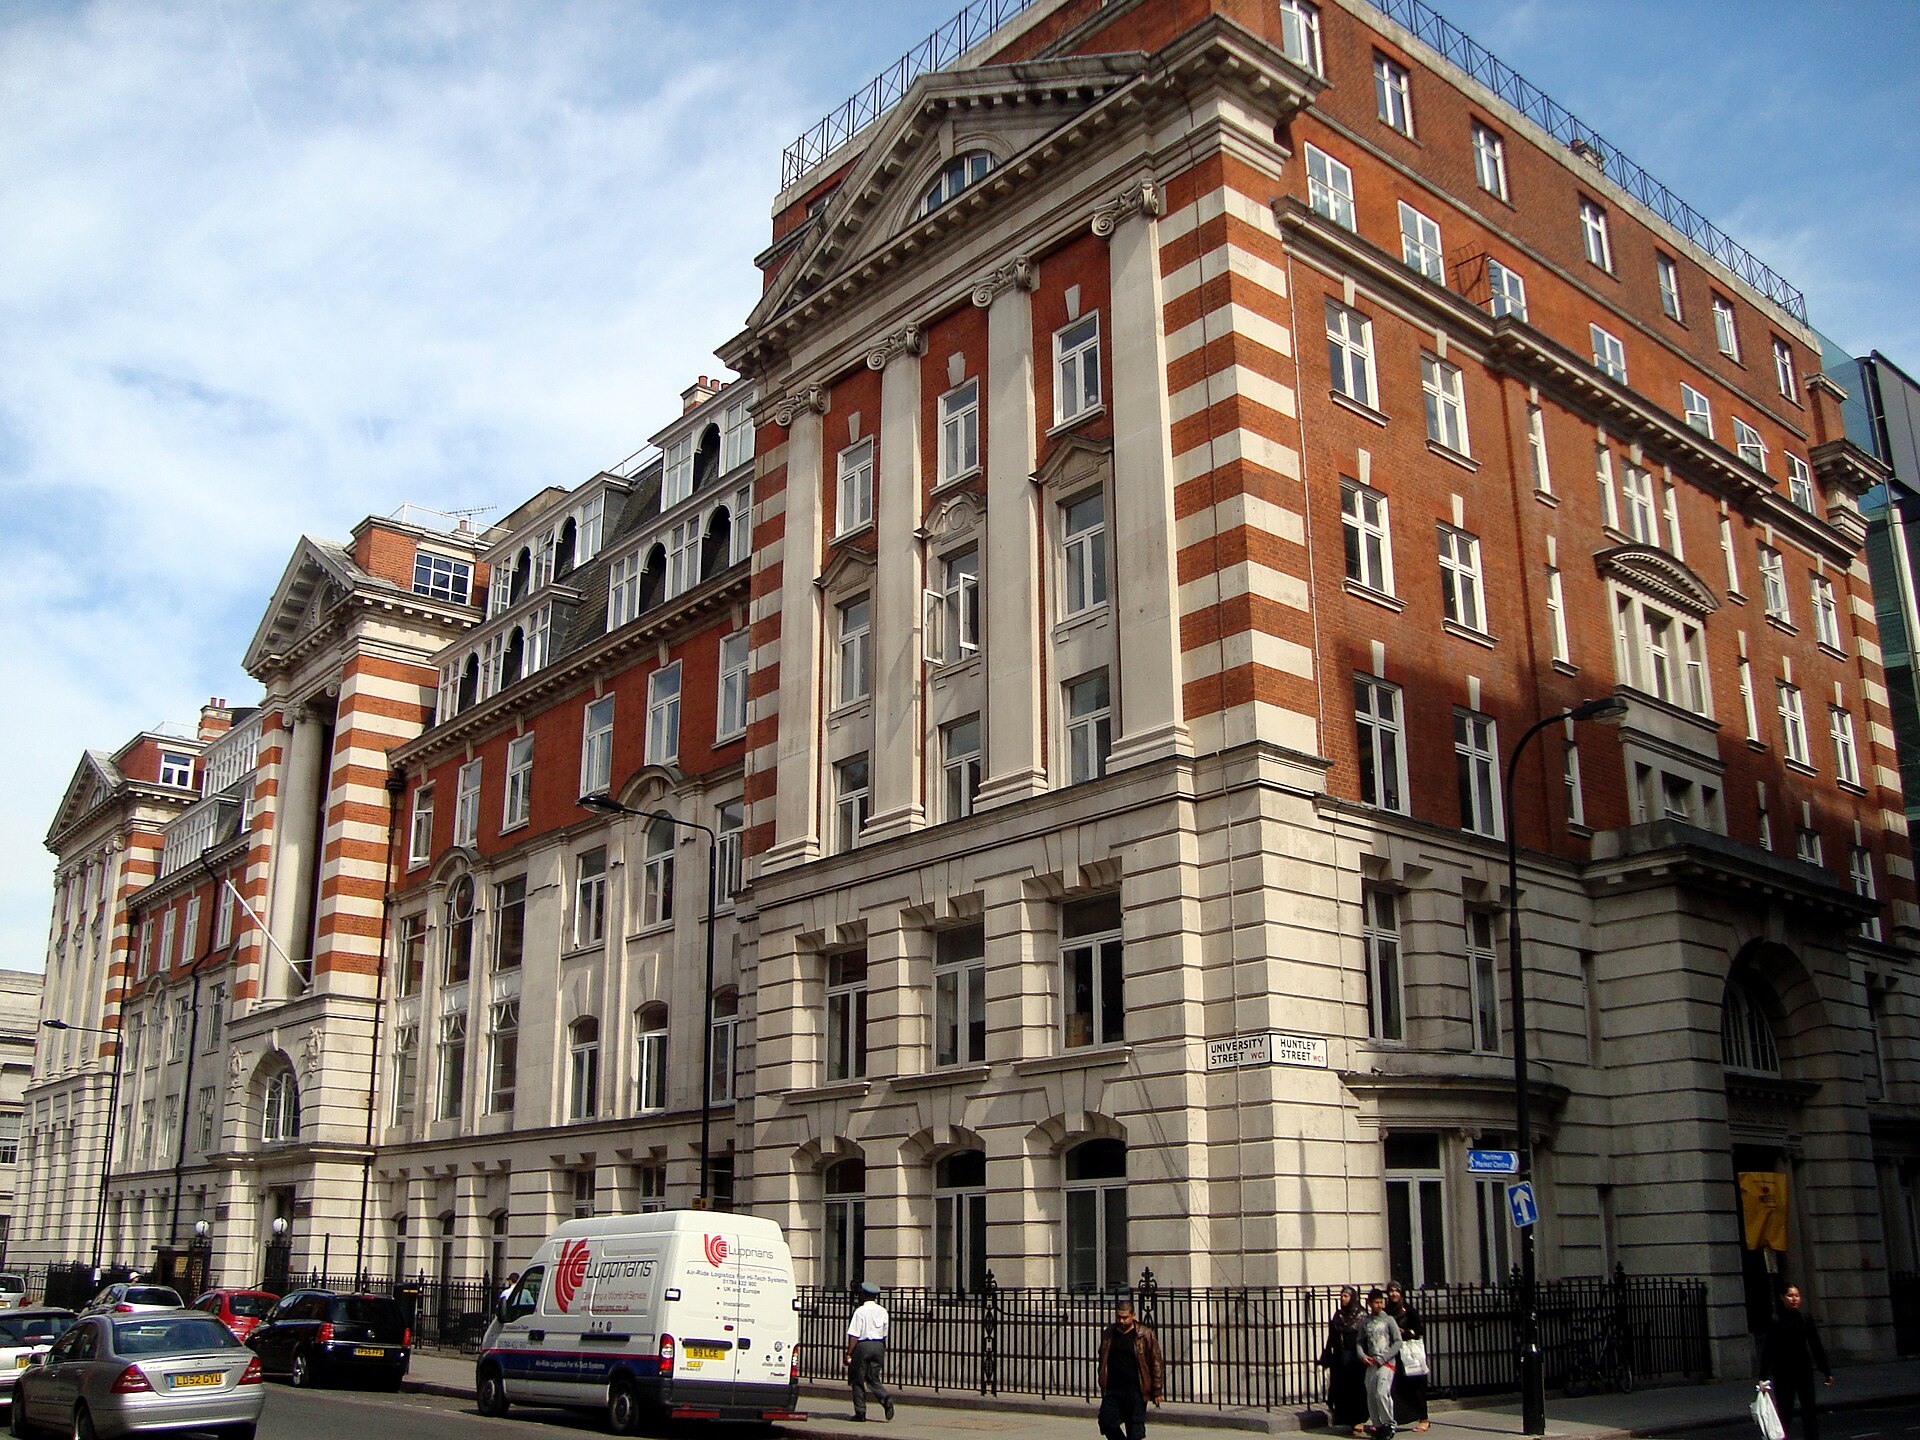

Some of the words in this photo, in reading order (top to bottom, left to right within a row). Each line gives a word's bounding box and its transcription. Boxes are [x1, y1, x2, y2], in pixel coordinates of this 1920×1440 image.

[1211, 1038, 1264, 1053] UNIVERSITY
[1280, 1038, 1316, 1051] HUNTLEY
[1211, 1051, 1245, 1064] STREET
[1250, 1051, 1266, 1059] WC1
[1281, 1050, 1311, 1062] STREET
